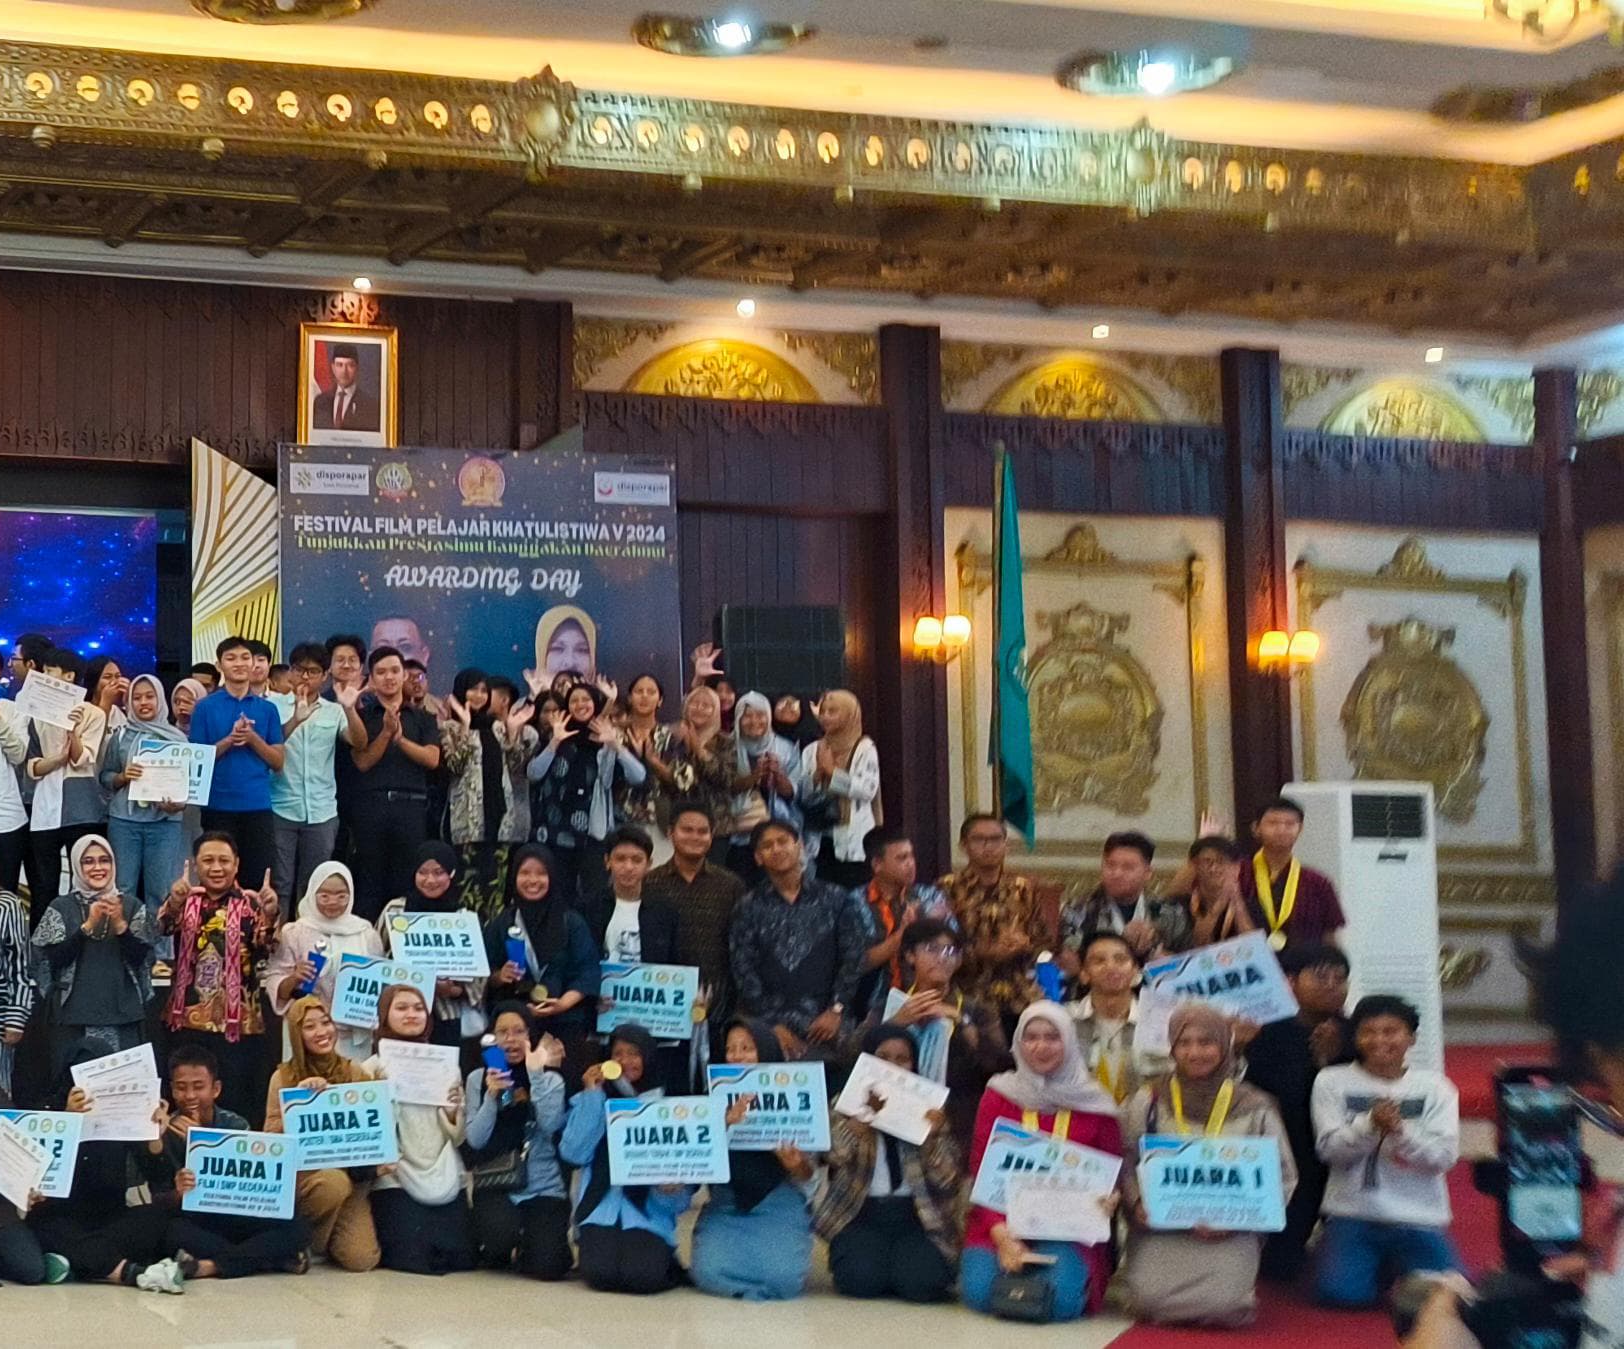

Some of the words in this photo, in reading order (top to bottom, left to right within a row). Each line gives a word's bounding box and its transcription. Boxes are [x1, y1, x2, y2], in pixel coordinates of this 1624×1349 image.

[316, 470, 366, 481] disporapar
[294, 515, 373, 533] FESTIVAL
[376, 517, 411, 535] FILM
[417, 518, 489, 537] PELAJAR
[493, 520, 609, 541] KHATULISTIWA
[612, 523, 624, 541] V
[627, 525, 666, 543] 2024
[530, 568, 582, 598] DAY
[404, 933, 456, 947] JUARA
[459, 933, 472, 947] 2
[613, 985, 666, 1006] JUARA
[672, 990, 684, 1007] 2
[797, 1092, 811, 1111] 3
[298, 1110, 361, 1133] JUARA
[366, 1109, 380, 1128] 2
[624, 1126, 689, 1146] JUARA
[696, 1125, 711, 1144] 2
[52, 1139, 64, 1158] 2
[199, 1156, 266, 1180] JUARA
[275, 1162, 283, 1181] 1
[1161, 1165, 1242, 1188] JUARA
[198, 1179, 216, 1189] FILM
